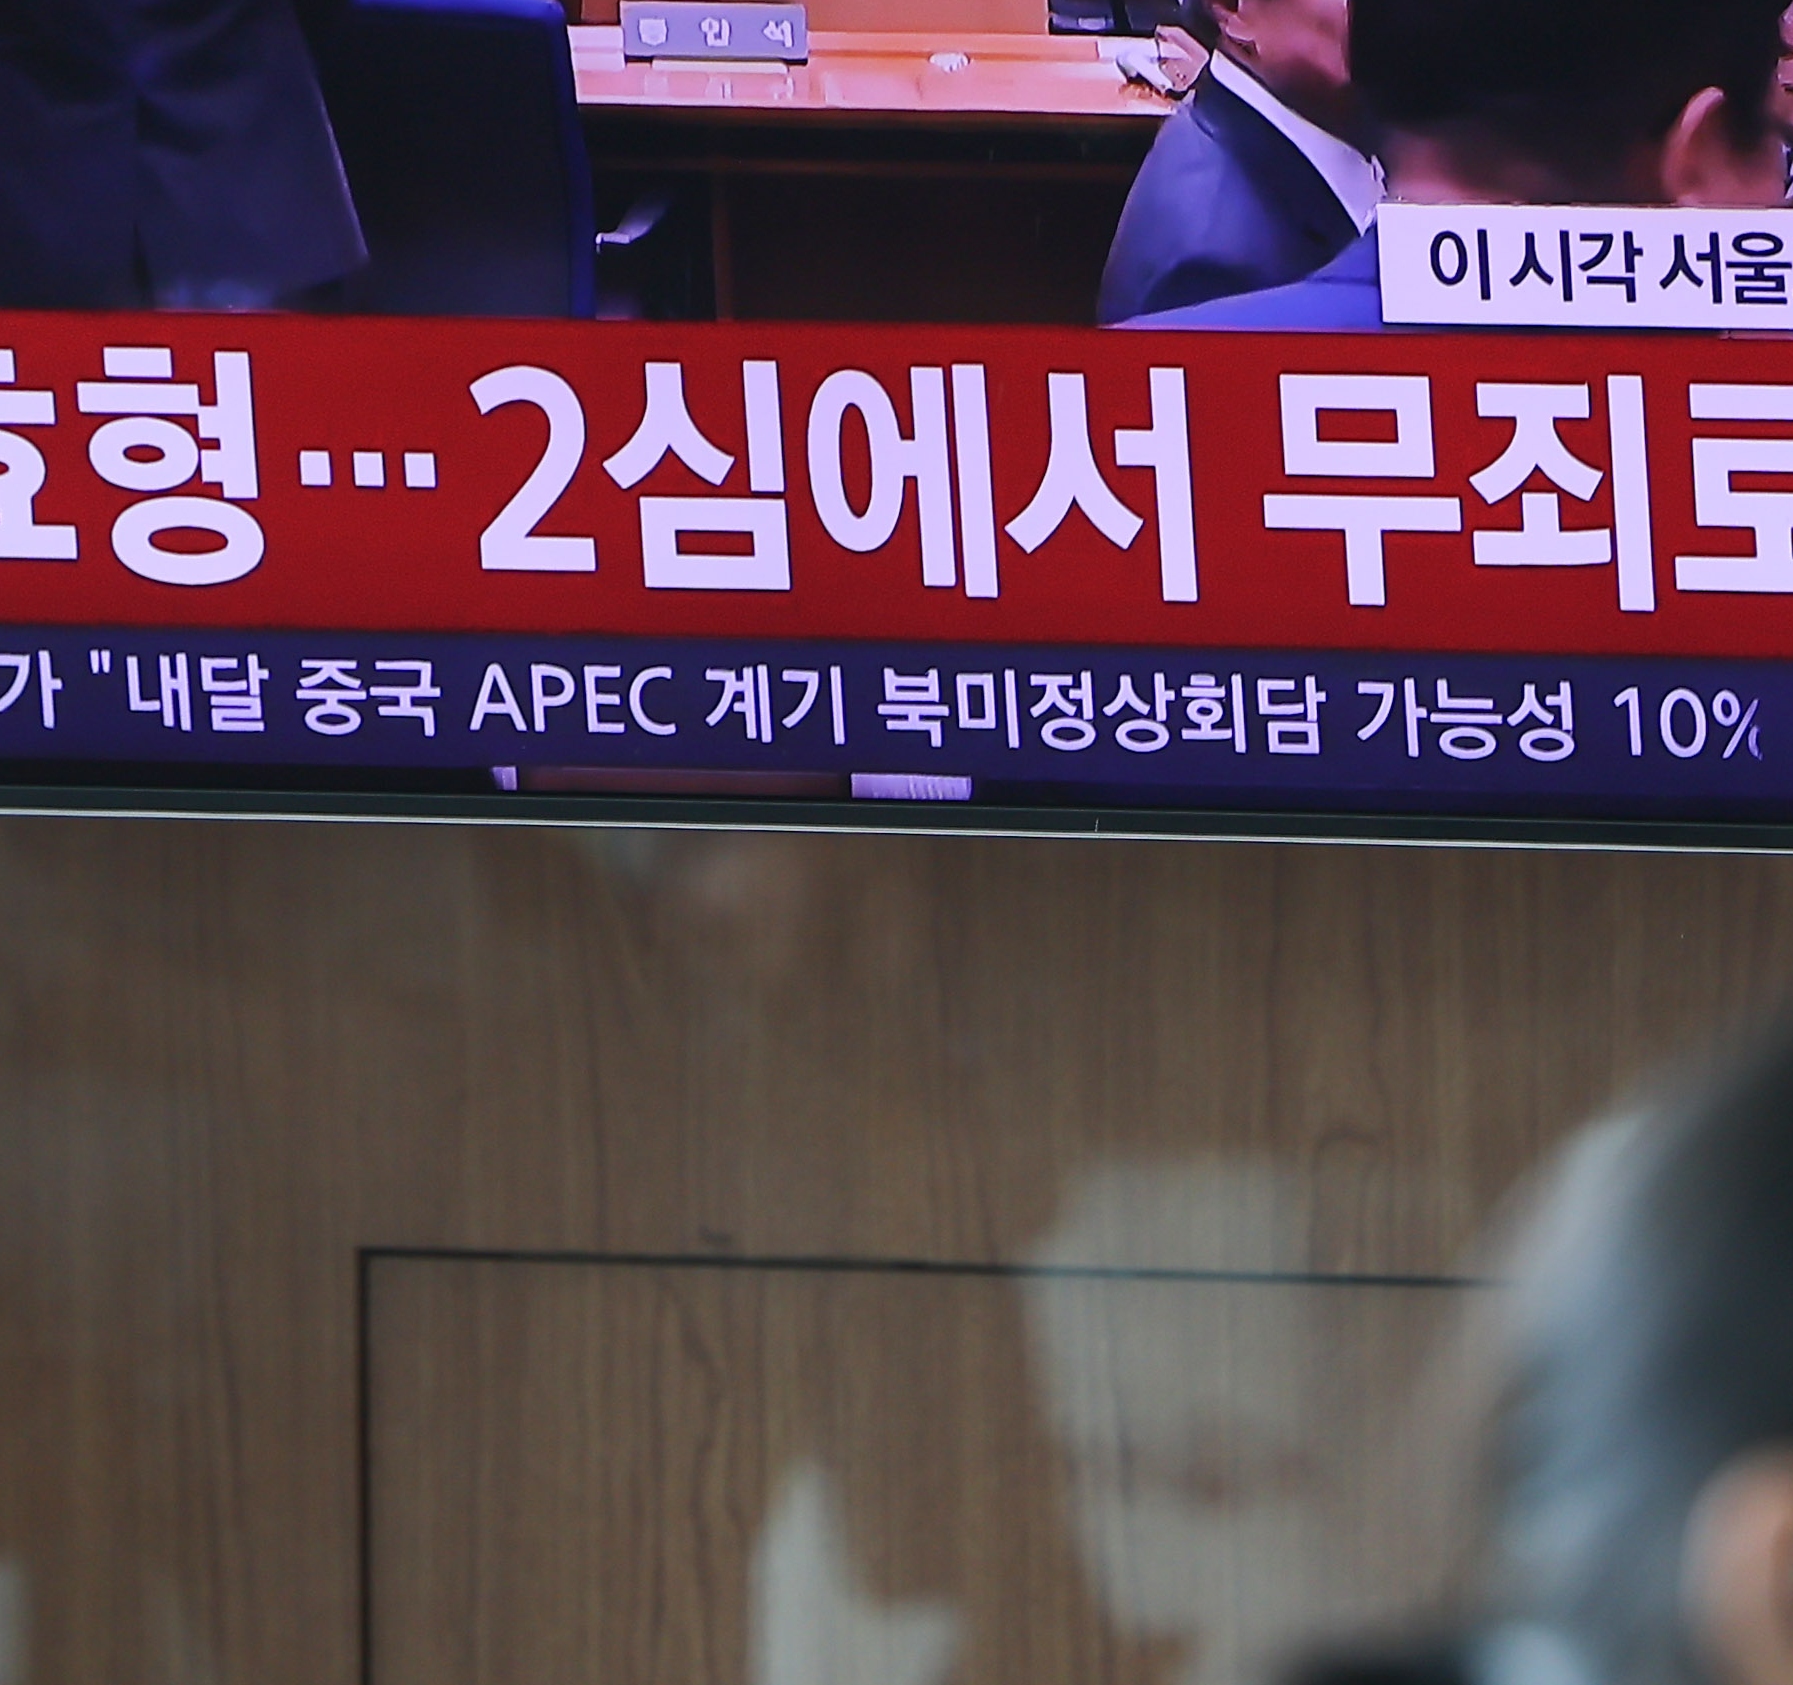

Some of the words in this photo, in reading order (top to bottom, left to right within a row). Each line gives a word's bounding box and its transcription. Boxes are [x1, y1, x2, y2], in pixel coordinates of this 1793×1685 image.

[1430, 229, 1491, 300] 이
[1509, 230, 1643, 303] 시각
[297, 661, 440, 735] 중국
[471, 664, 675, 734] APEC
[706, 666, 844, 743] 계기
[878, 669, 1325, 753] 북미정상회담
[1358, 679, 1574, 760] 가능성
[1612, 684, 1763, 761] 10%
